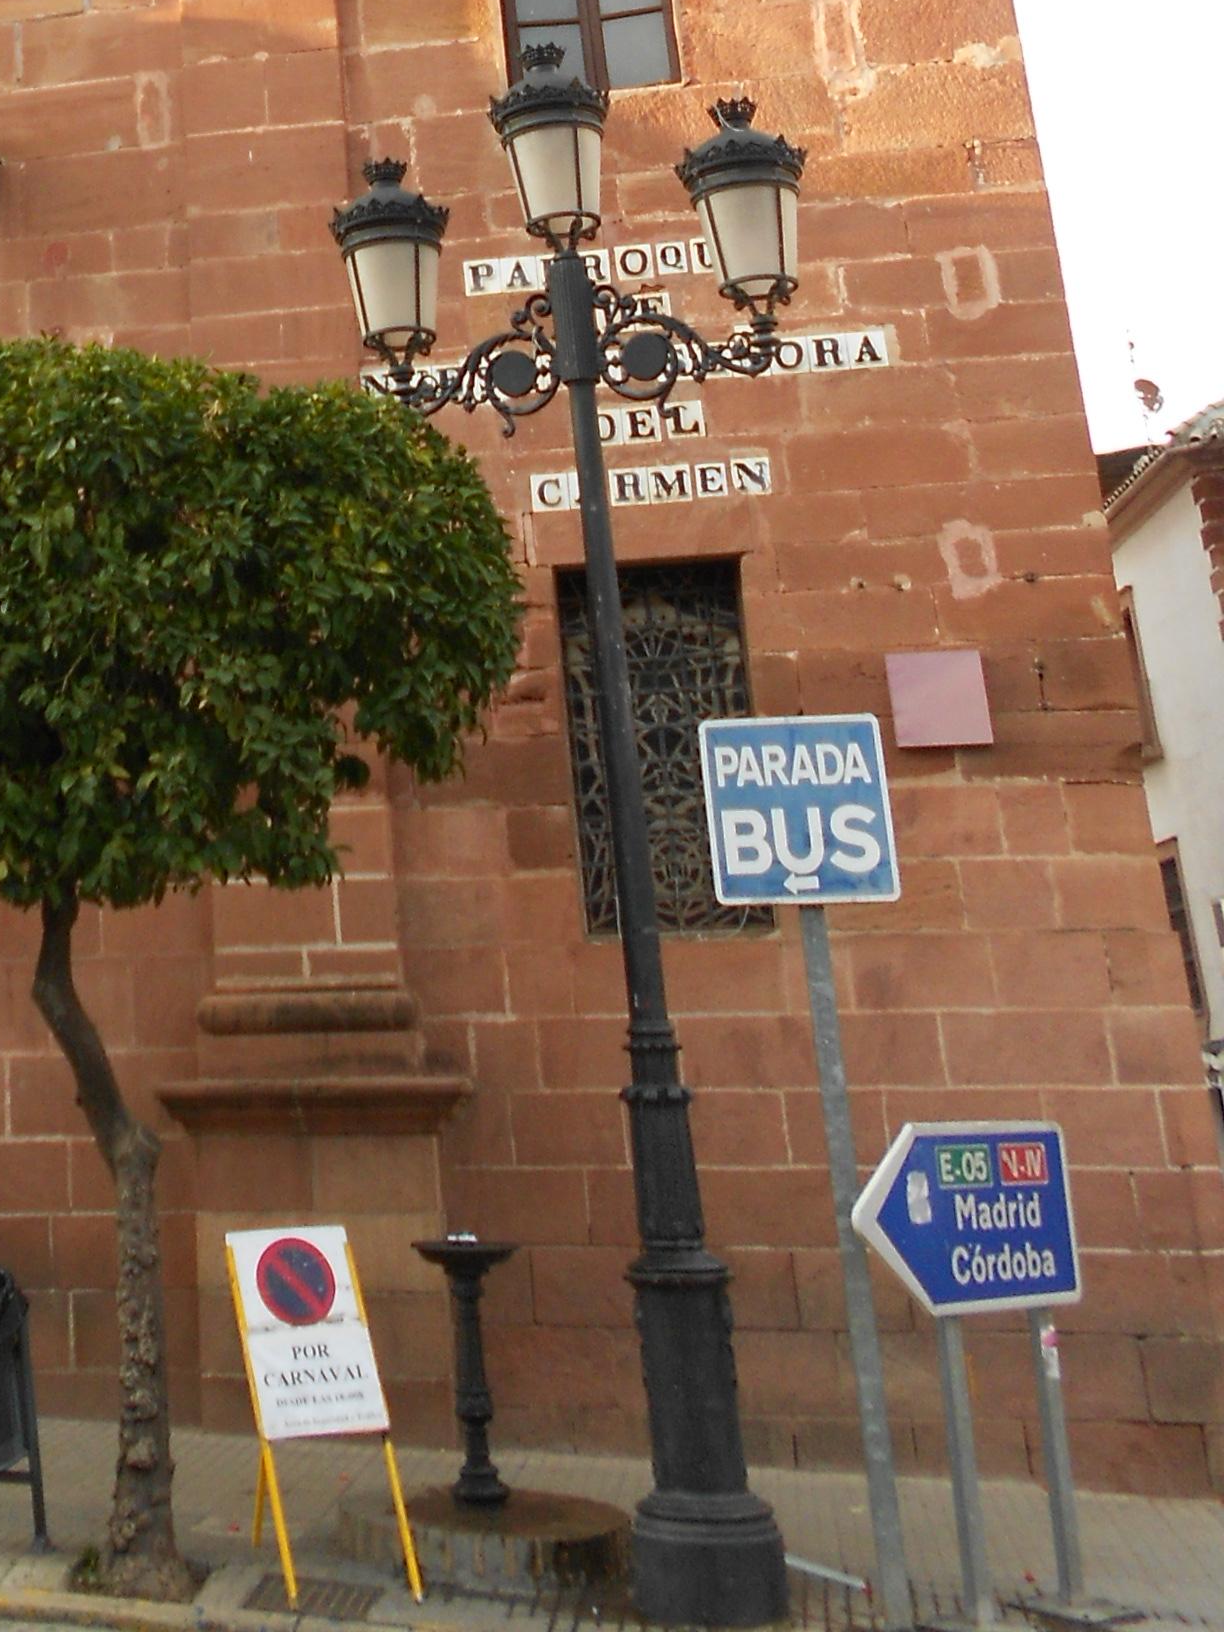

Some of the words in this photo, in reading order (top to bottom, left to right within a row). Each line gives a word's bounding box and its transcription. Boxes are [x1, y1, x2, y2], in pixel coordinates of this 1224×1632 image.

[537, 461, 769, 508] CRMEN
[714, 742, 872, 787] PARADA
[721, 804, 881, 875] BUS
[939, 1151, 988, 1183] E-05
[954, 1192, 1042, 1231] Madrid
[951, 1241, 1057, 1286] Córdoba
[291, 1344, 330, 1361] POR
[263, 1363, 369, 1388] CARNAVAL
